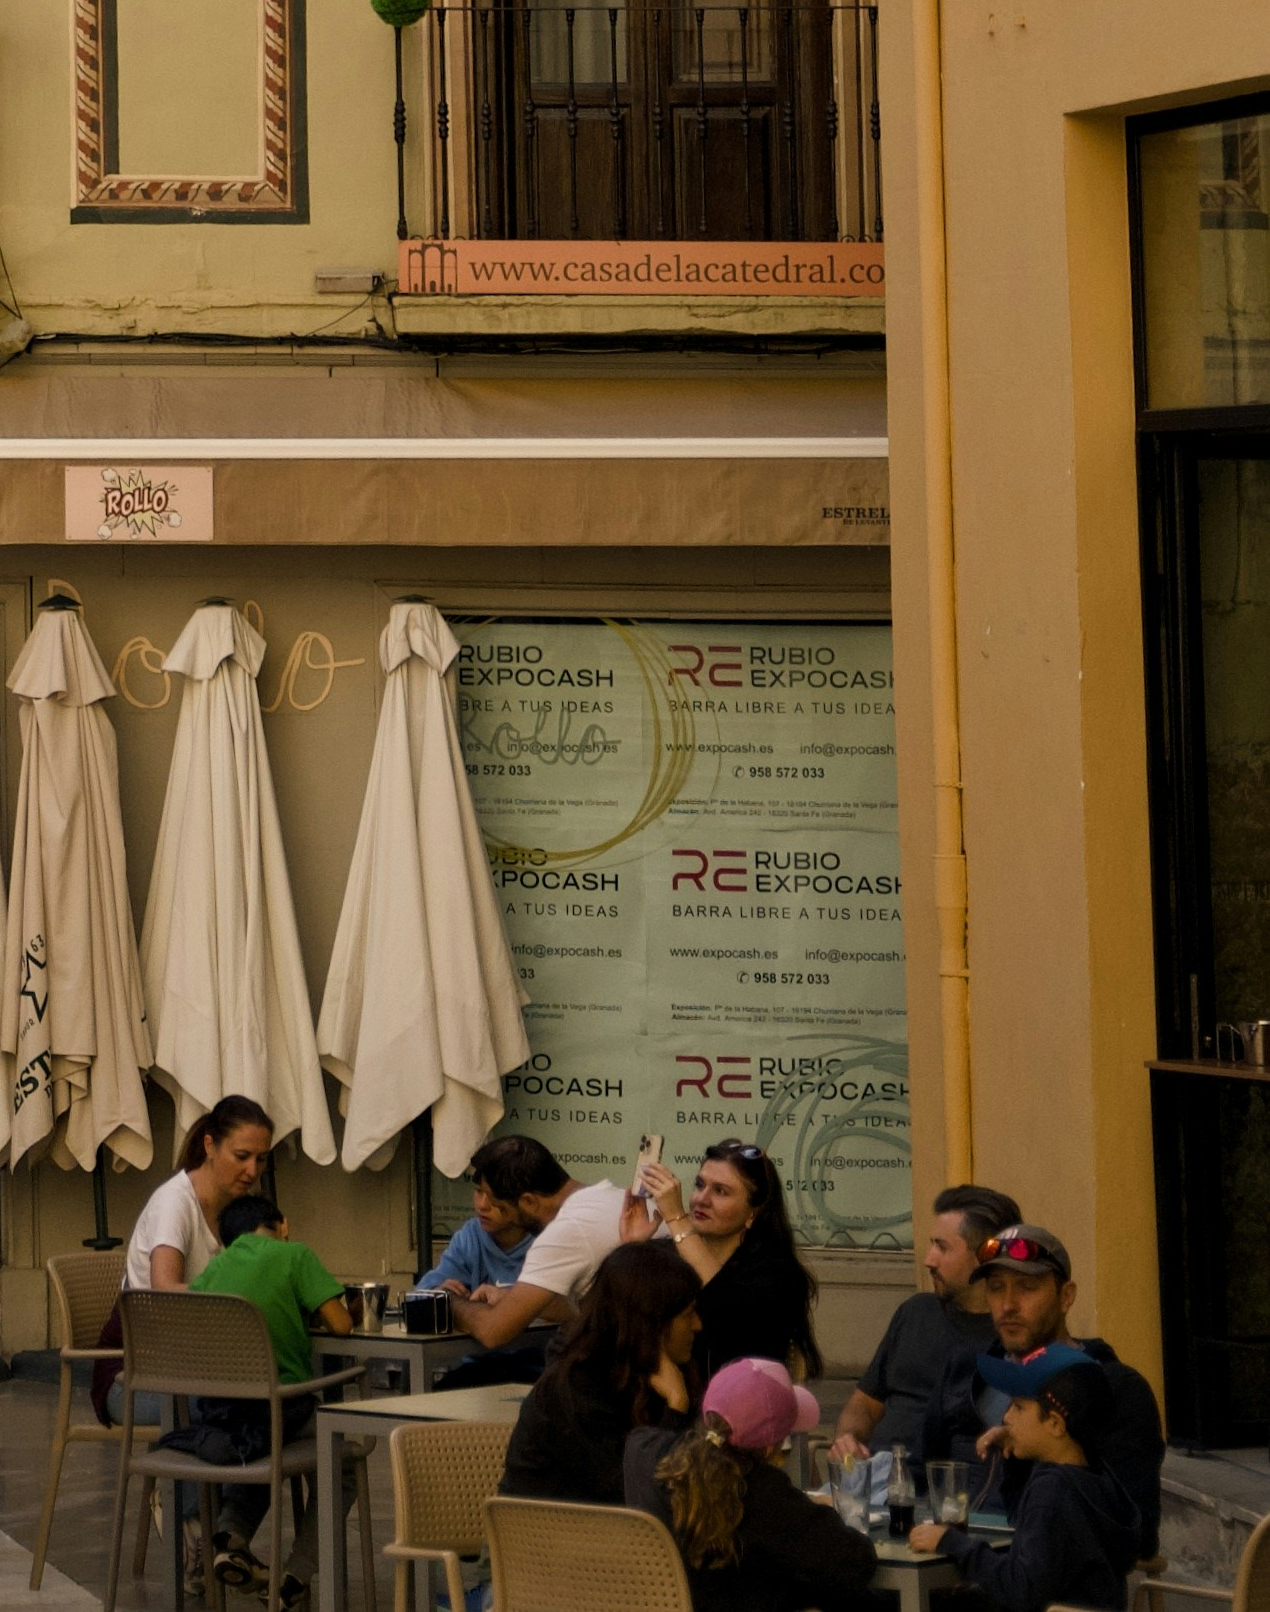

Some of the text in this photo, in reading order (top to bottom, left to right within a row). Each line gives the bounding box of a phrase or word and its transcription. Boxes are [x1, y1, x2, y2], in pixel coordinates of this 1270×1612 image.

[468, 253, 885, 286] www.casadelacatedral.co
[104, 486, 169, 518] ROLLO
[821, 507, 891, 519] ESTREL
[459, 645, 543, 664] RUBIO
[750, 646, 835, 666] RUBIO
[459, 667, 614, 688] EXPOCASH
[502, 700, 512, 712] A
[519, 700, 553, 713] TUS
[561, 700, 614, 713] IDEAS
[668, 700, 728, 714] BARRA
[735, 701, 787, 714] LIBRE
[794, 702, 804, 714] A
[812, 702, 846, 715] TUS
[483, 765, 505, 776] 572
[509, 765, 531, 776] 033
[749, 767, 825, 779] 958 572 033
[755, 850, 841, 871] RUBIO
[506, 902, 619, 918] A TUS IDEAS
[672, 904, 733, 918] BARRA
[740, 906, 792, 920] LIBRE
[799, 908, 809, 920] A
[817, 907, 851, 921] TUS
[669, 947, 779, 961] www.expocash.es
[754, 972, 830, 985] 958 572 033
[510, 1108, 623, 1124] A TUS IDEAS
[676, 1111, 737, 1125] BARRA
